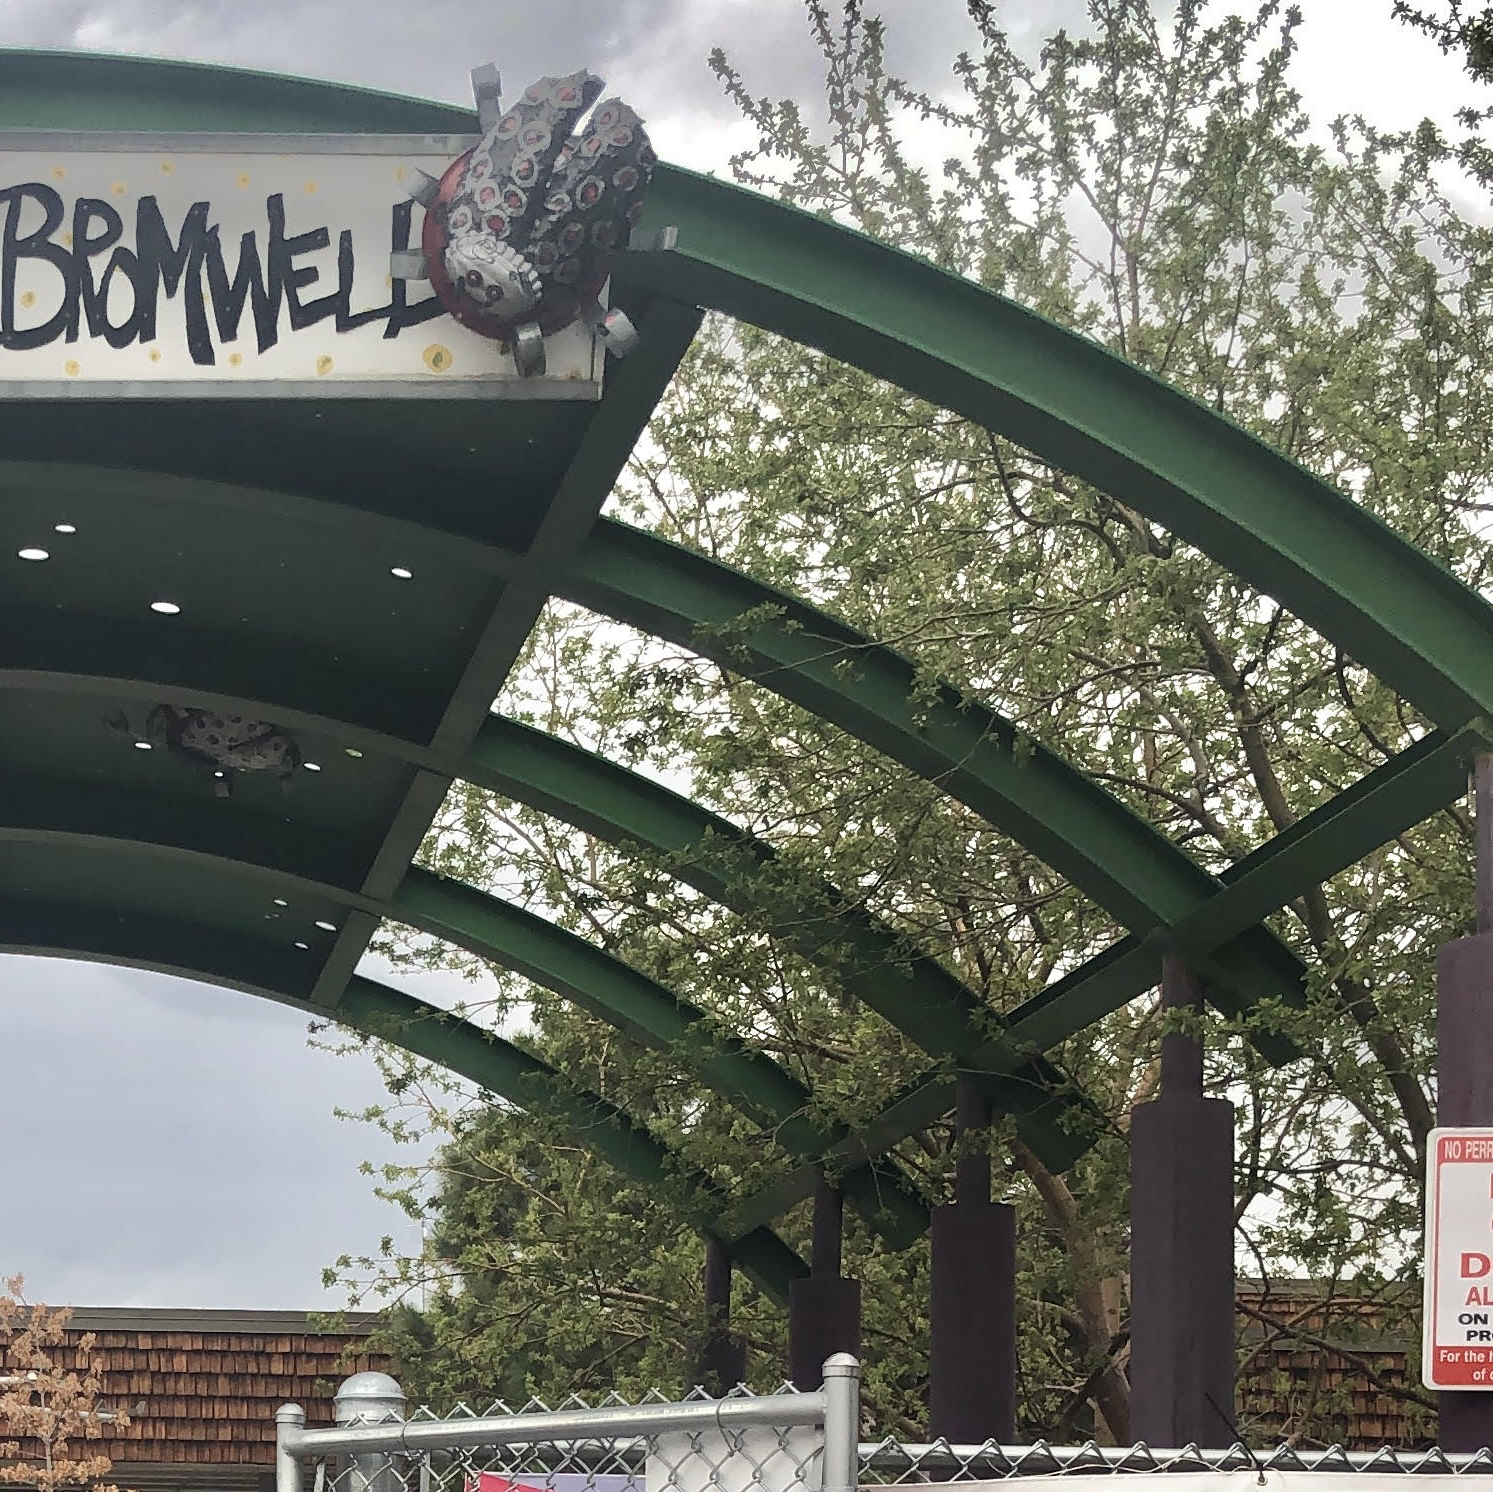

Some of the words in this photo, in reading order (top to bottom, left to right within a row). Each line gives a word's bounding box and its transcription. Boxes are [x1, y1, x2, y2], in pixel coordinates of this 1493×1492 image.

[1444, 1140, 1462, 1160] NO
[1458, 1313, 1489, 1325] ON
[1466, 1330, 1493, 1341] PR
[1440, 1349, 1461, 1363] For
[1464, 1350, 1485, 1363] the
[1472, 1367, 1487, 1381] of
